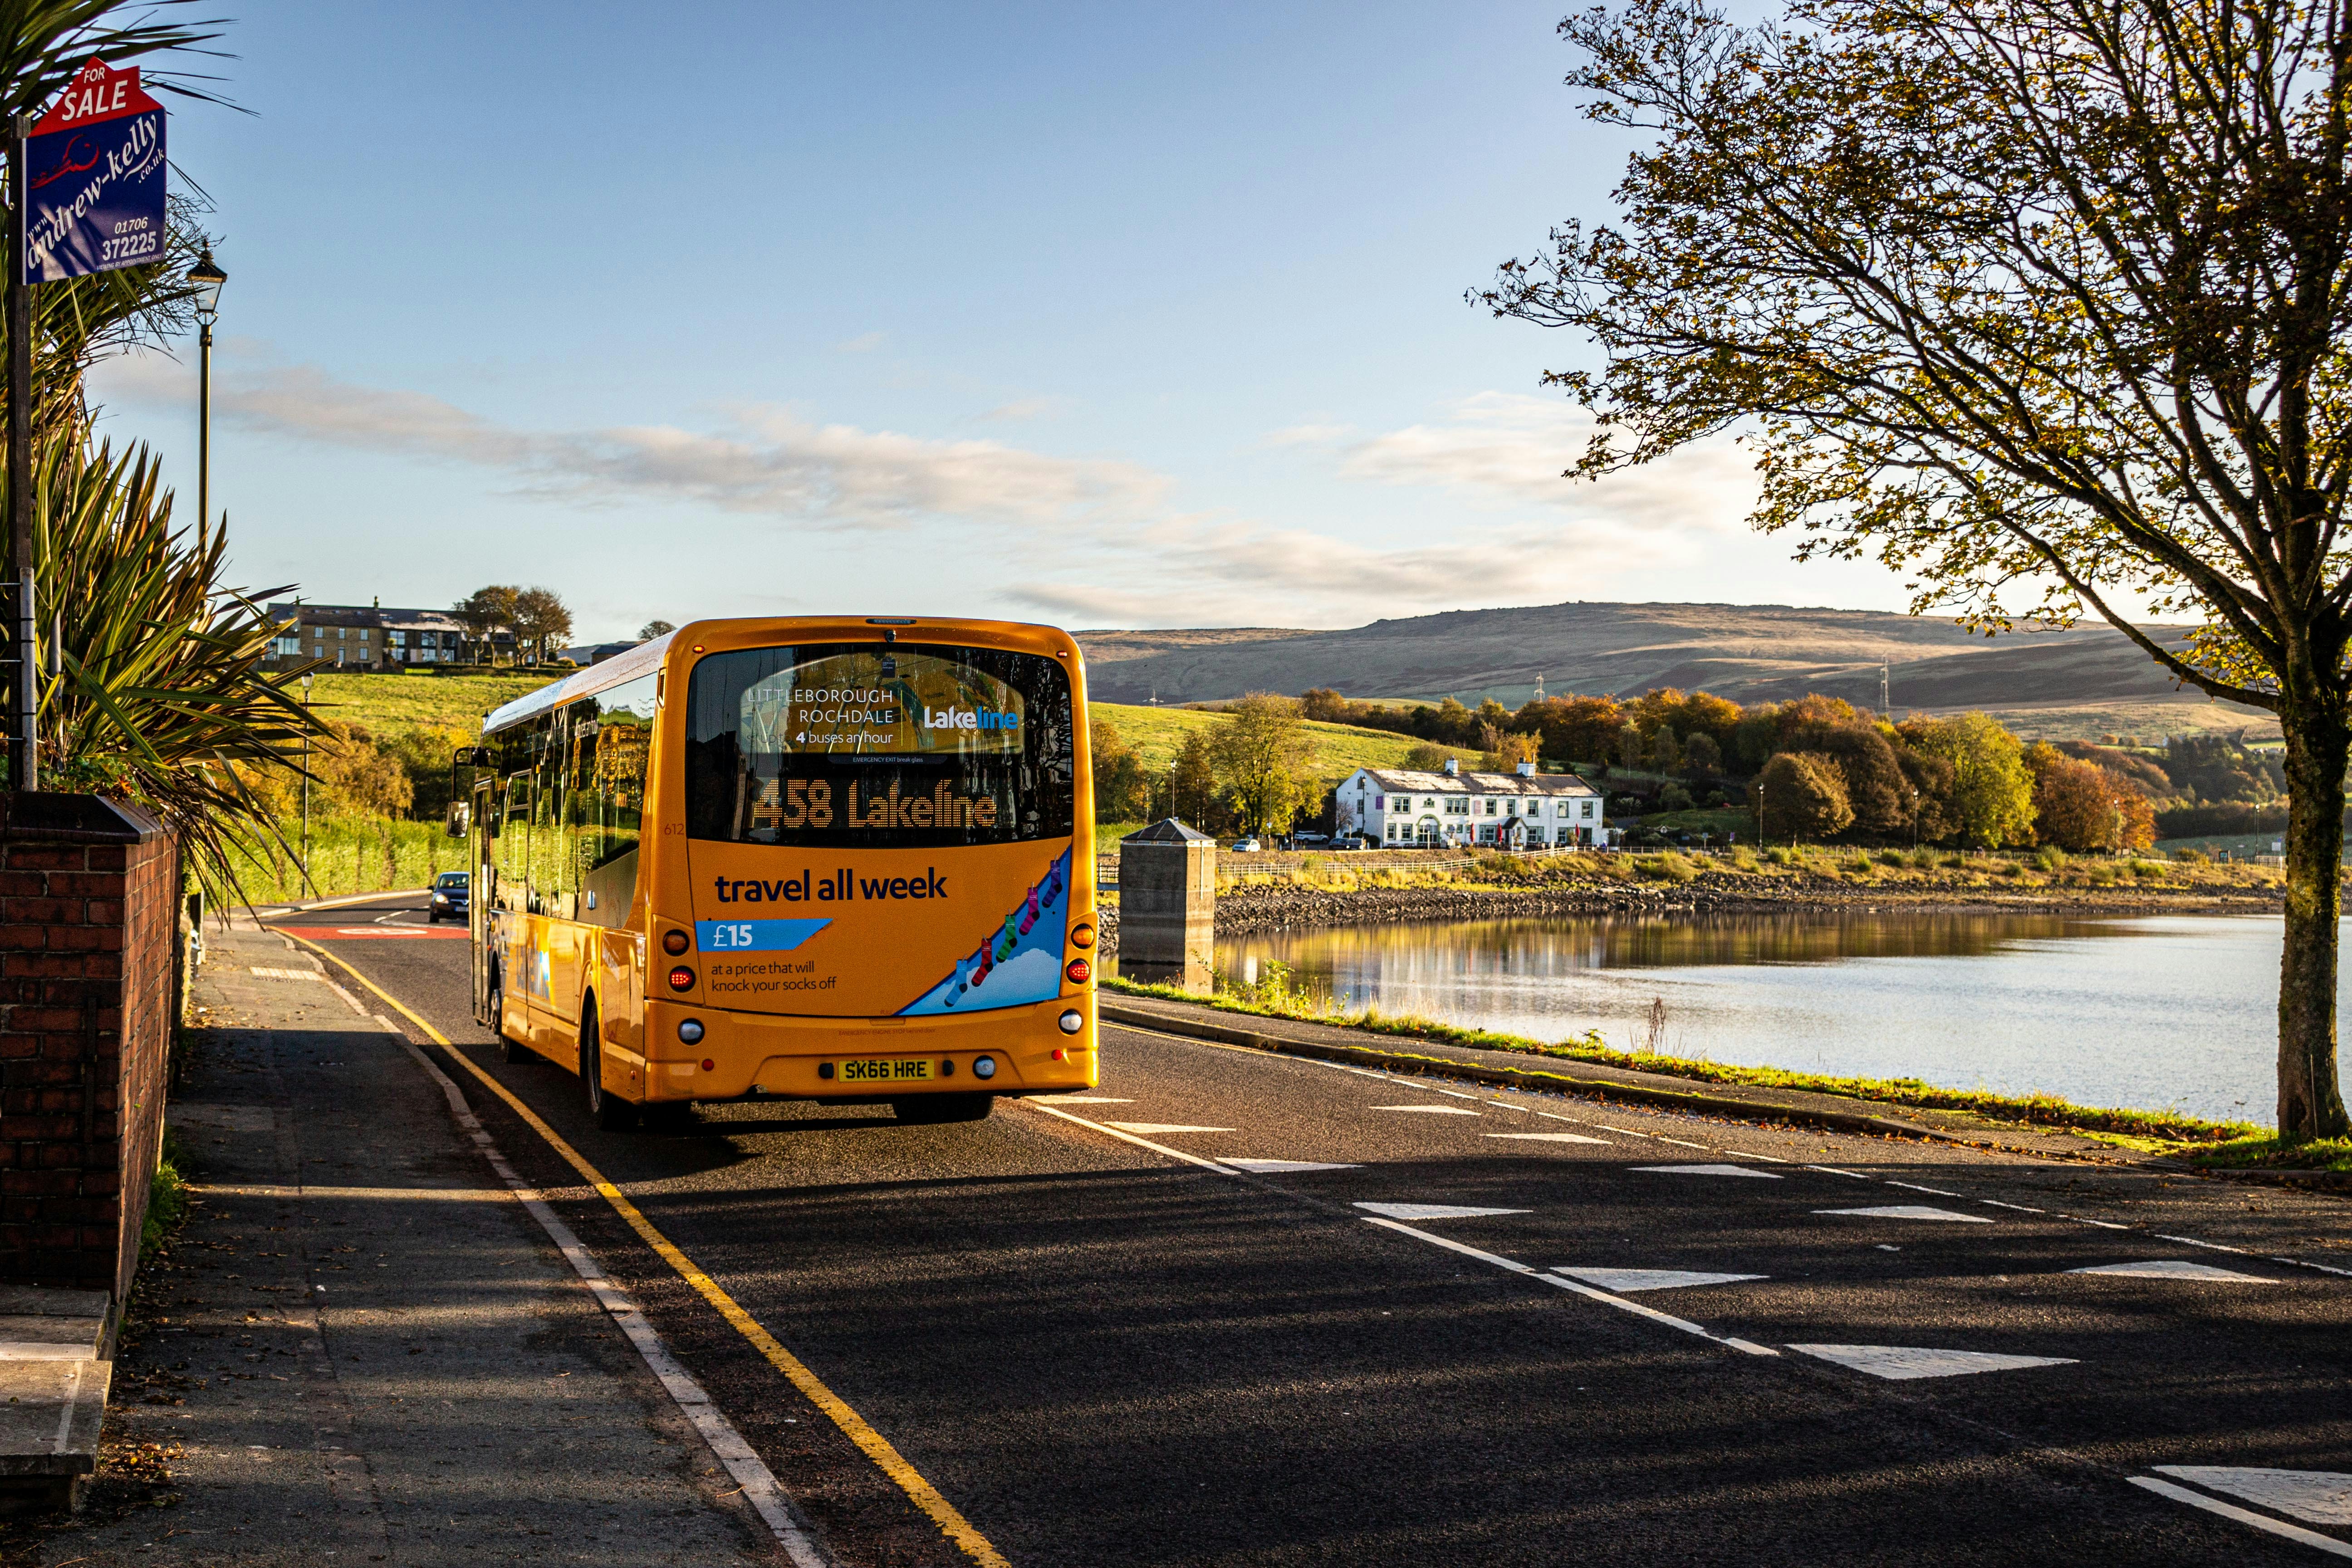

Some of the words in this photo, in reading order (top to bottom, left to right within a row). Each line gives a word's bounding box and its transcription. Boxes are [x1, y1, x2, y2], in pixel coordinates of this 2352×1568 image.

[84, 67, 105, 83] FOR
[62, 80, 128, 121] SALE
[138, 147, 165, 184] .co.uk
[115, 217, 148, 234] 01706
[103, 231, 156, 260] 372225
[122, 255, 151, 266] APPOINTMENT
[748, 689, 892, 702] LITTLEBOROUGH
[800, 710, 893, 723] ROCHDALE
[924, 705, 1019, 729] Lakeline
[796, 732, 805, 743] 4
[809, 730, 843, 743] buses
[846, 734, 861, 743] an
[864, 730, 893, 743] hour
[754, 779, 833, 828] 458
[849, 779, 997, 827] Lakeline
[664, 823, 684, 835] 612
[715, 869, 810, 902] travel
[818, 868, 853, 901] all
[859, 867, 948, 899] week
[713, 925, 753, 946] £15
[711, 965, 723, 975] at
[726, 966, 732, 975] a
[735, 963, 766, 977] price
[769, 961, 793, 974] that
[795, 960, 814, 973] will
[712, 979, 750, 992] knock
[752, 981, 780, 993] your
[783, 977, 817, 990] socks
[819, 976, 837, 989] off
[845, 1062, 889, 1078] SK66
[894, 1061, 926, 1078] HRE
